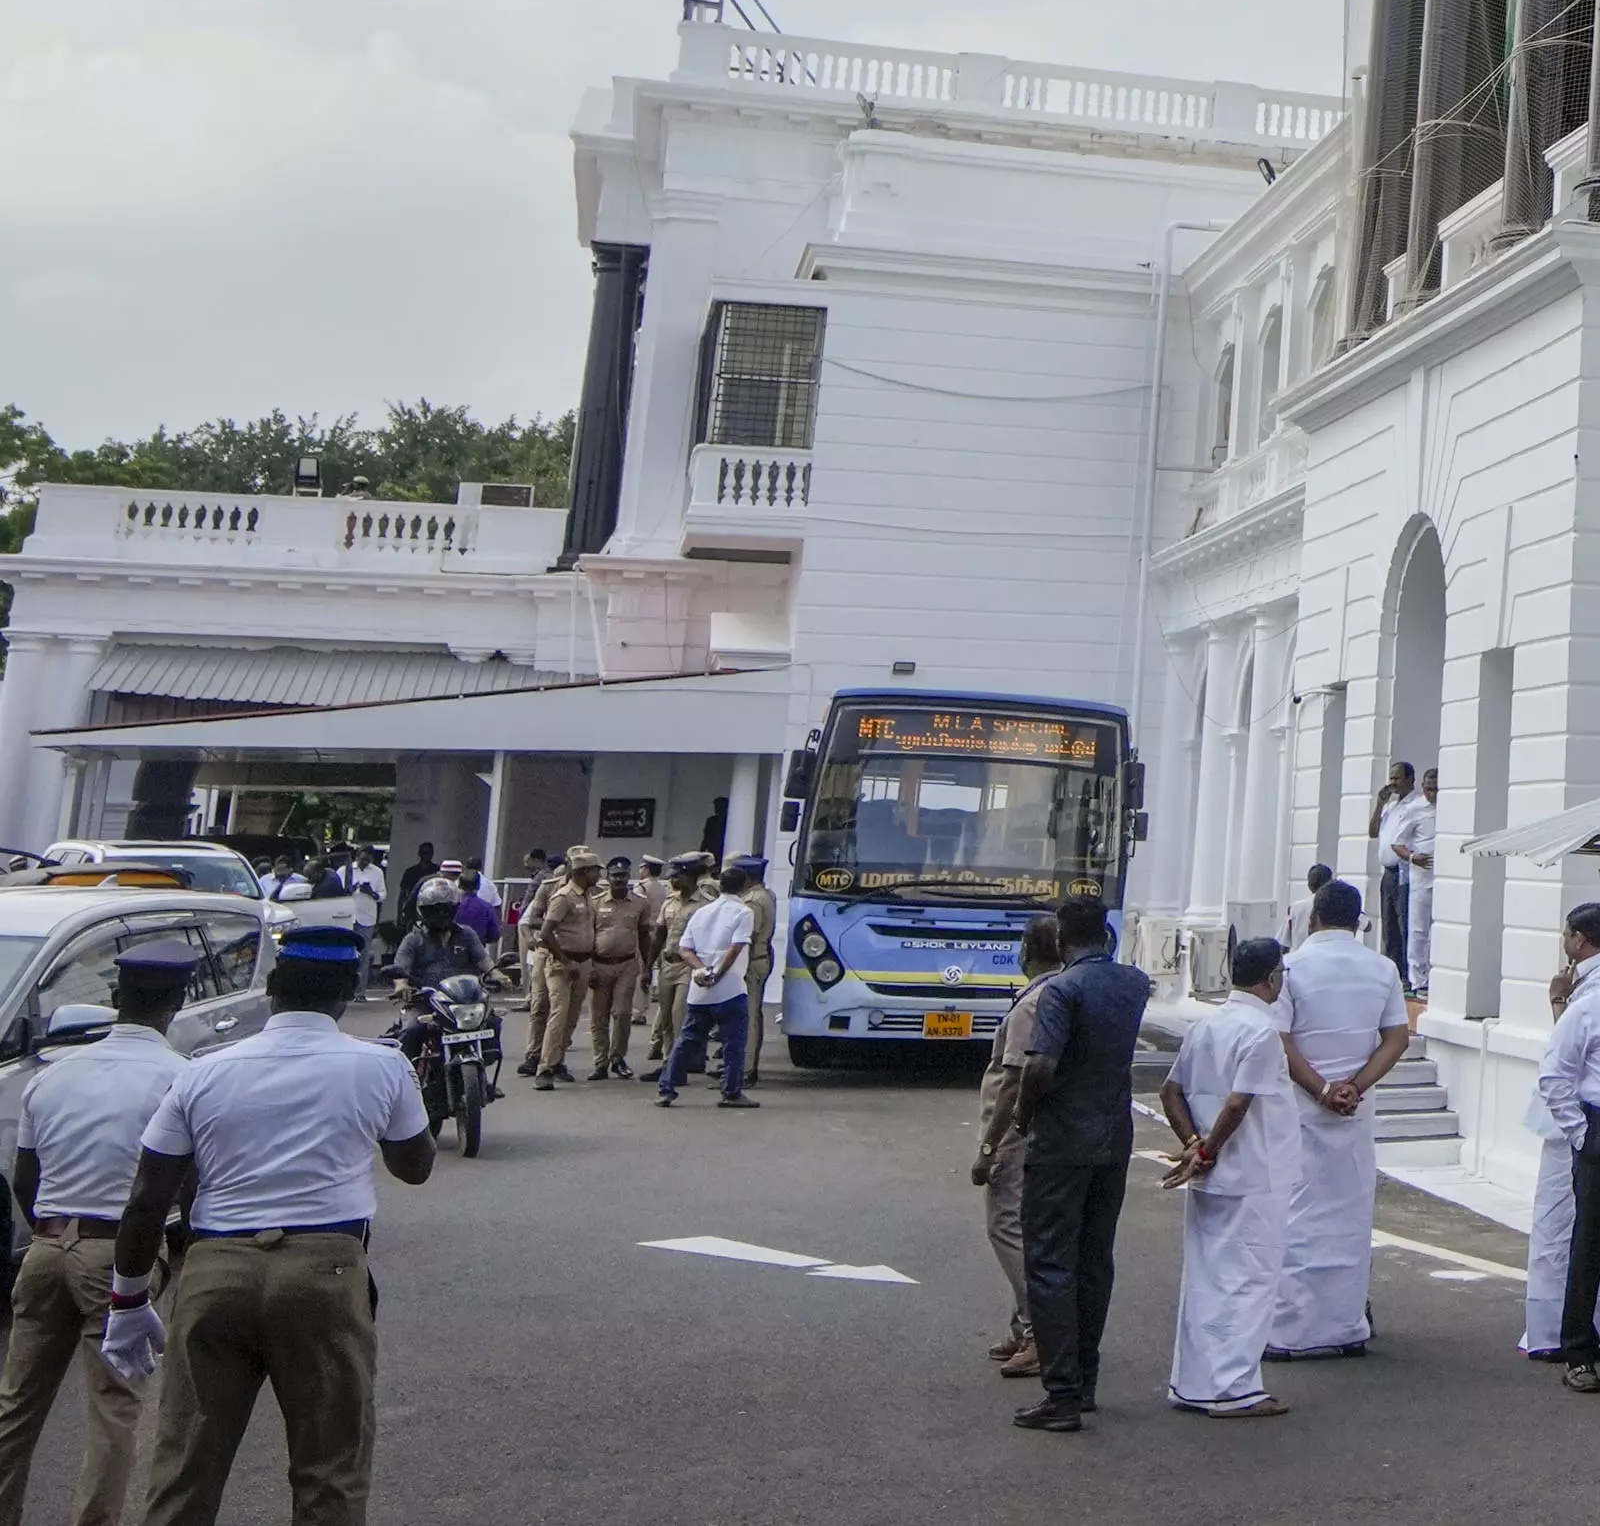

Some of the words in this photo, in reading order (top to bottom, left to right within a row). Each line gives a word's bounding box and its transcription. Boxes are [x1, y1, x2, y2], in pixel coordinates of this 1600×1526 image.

[859, 717, 895, 739] MTC
[992, 719, 1070, 736] SPECIAL
[636, 808, 646, 827] 3
[819, 874, 849, 887] MTC
[1070, 881, 1100, 895] MTC
[953, 942, 1012, 952] LEYLAND
[992, 955, 1014, 966] CDK
